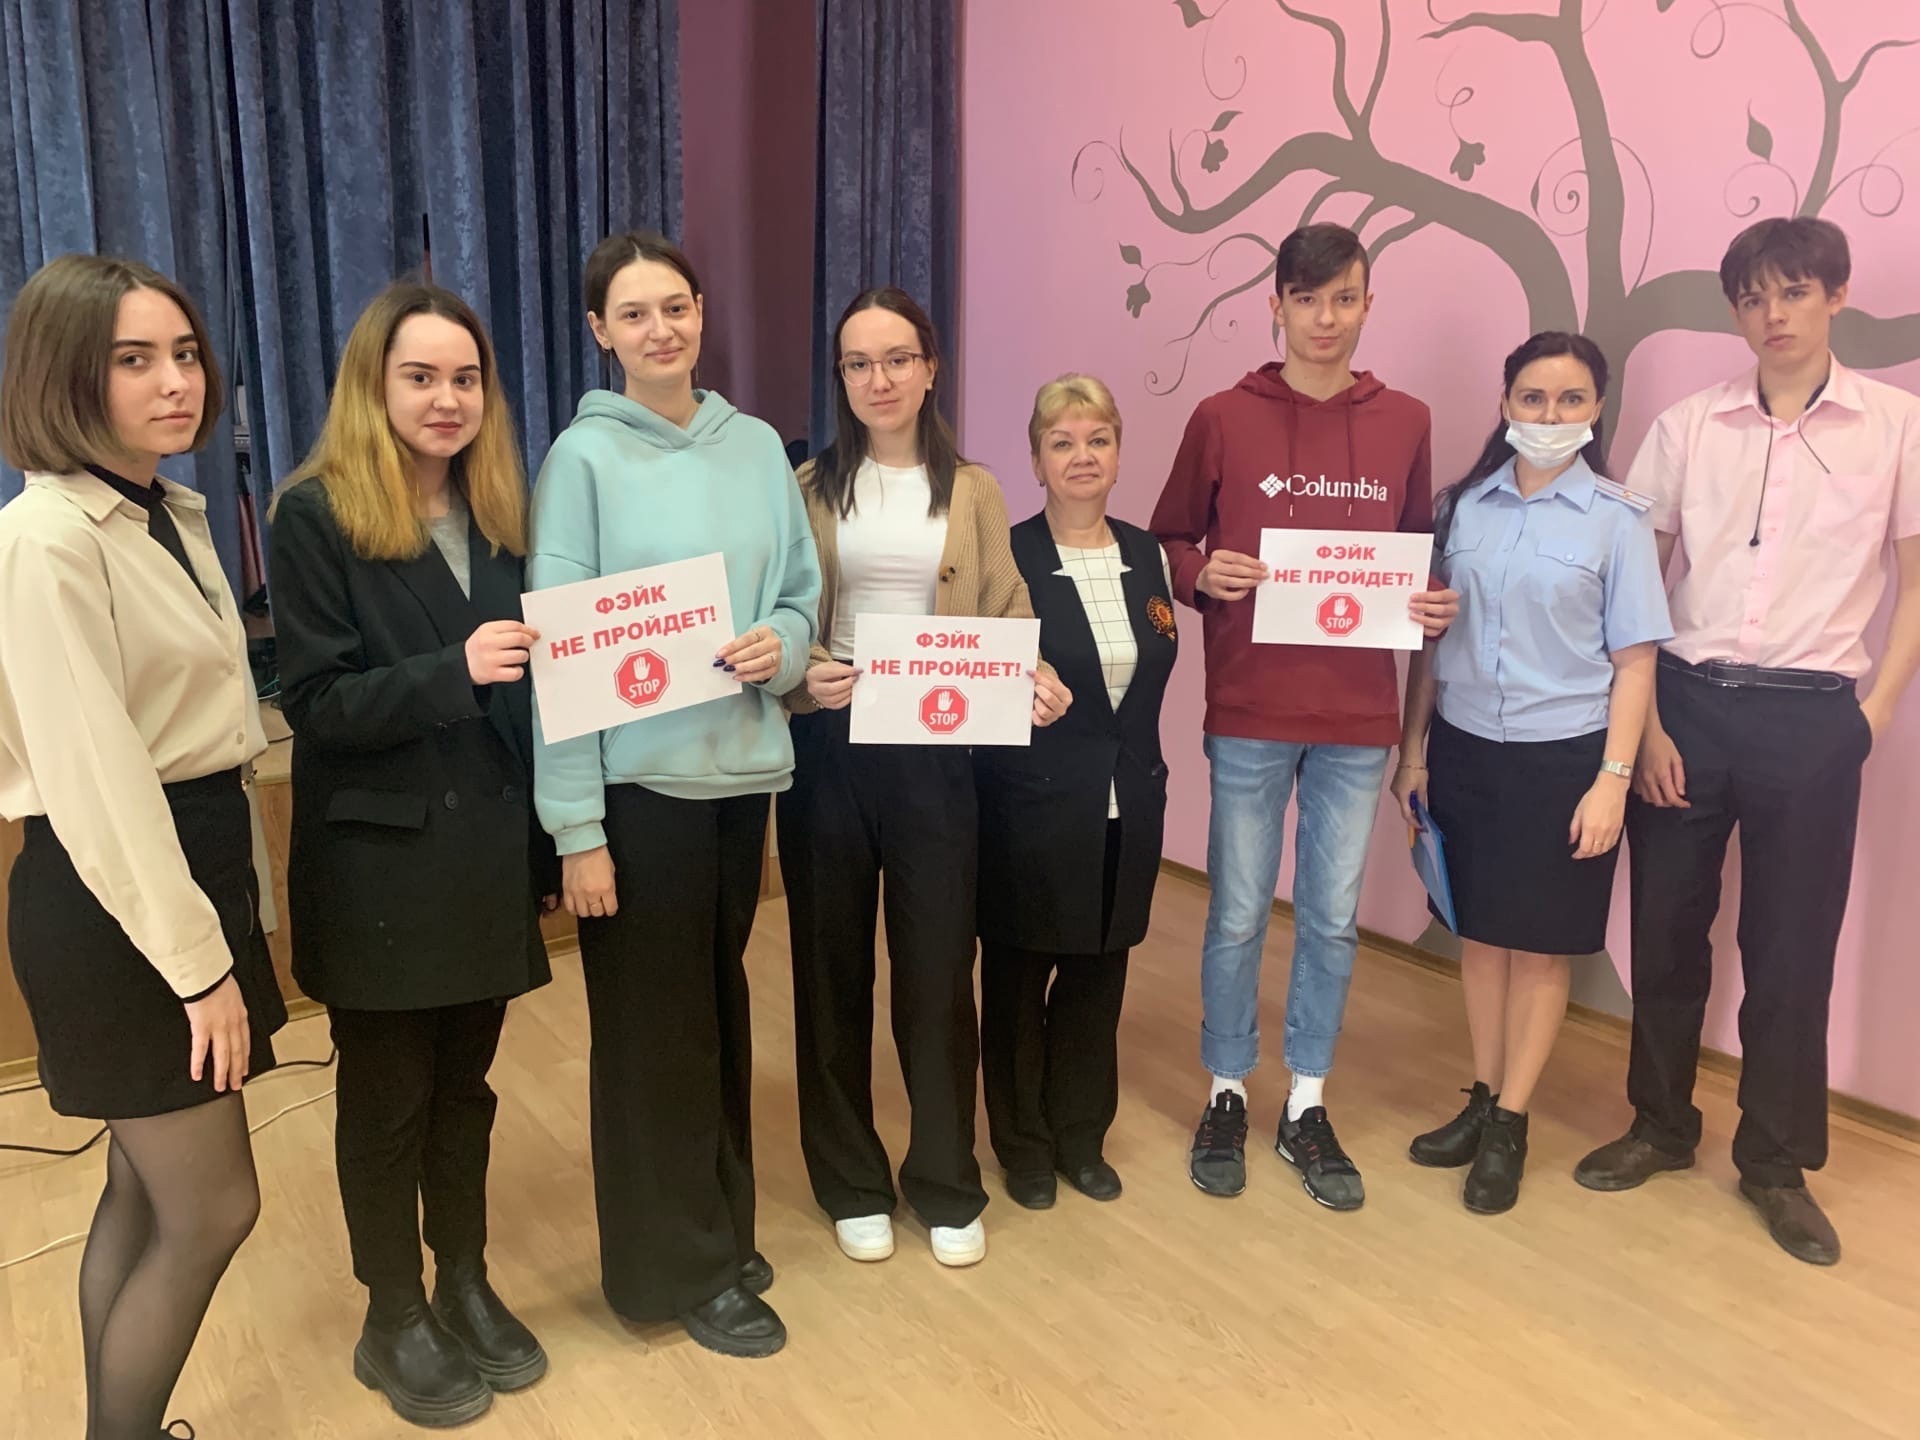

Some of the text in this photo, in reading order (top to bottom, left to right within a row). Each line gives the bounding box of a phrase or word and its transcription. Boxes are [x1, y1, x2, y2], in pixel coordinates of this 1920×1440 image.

[1286, 474, 1388, 502] Columbia
[1316, 544, 1376, 560] ФЭЙК
[1274, 568, 1413, 588] НЕ ПРОЙДЕТ!
[595, 584, 667, 614] ФЭЙК
[550, 606, 717, 660] НЕ ПРОЙДЕТ!
[1325, 617, 1353, 629] STOP
[916, 630, 981, 649] ФЭЙК
[871, 658, 1021, 679] НЕ ПРОЙДЕТ!
[628, 678, 661, 699] STOP
[929, 712, 959, 726] STOP
